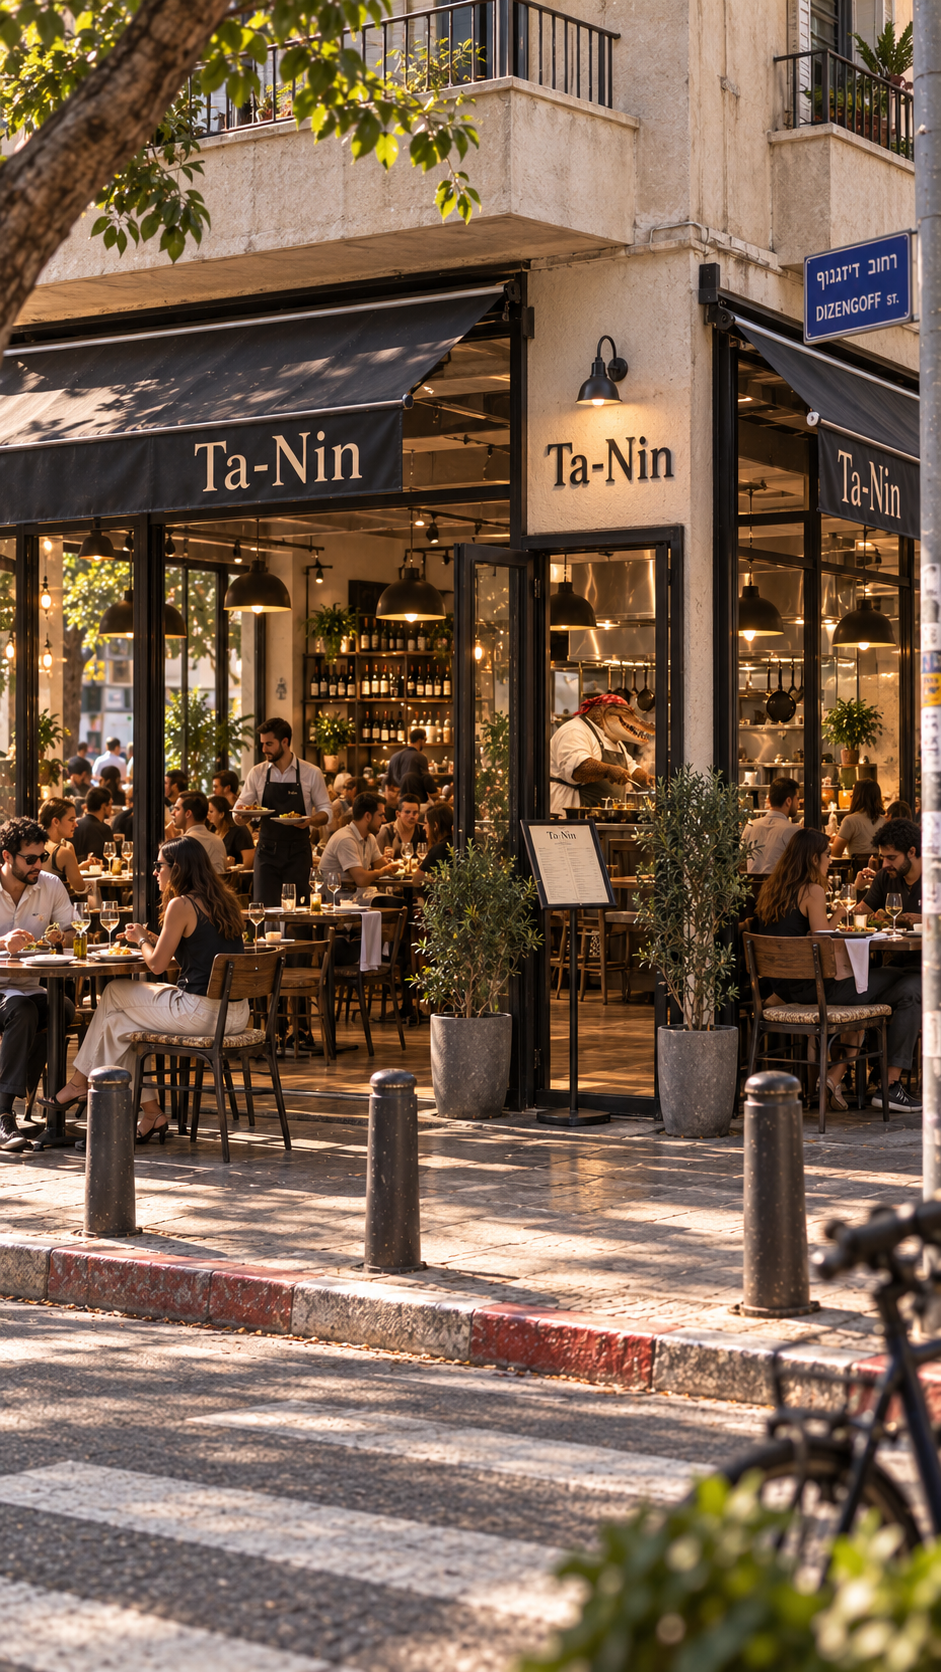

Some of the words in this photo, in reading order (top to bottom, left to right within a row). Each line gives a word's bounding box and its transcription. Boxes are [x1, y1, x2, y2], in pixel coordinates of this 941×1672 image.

[868, 253, 898, 275] רחוב
[816, 291, 882, 322] DIZENGOFF
[886, 293, 900, 306] ST.
[194, 430, 363, 492] Ta-Nin
[547, 436, 674, 487] Ta-Nin
[837, 449, 902, 519] Ta-Nin
